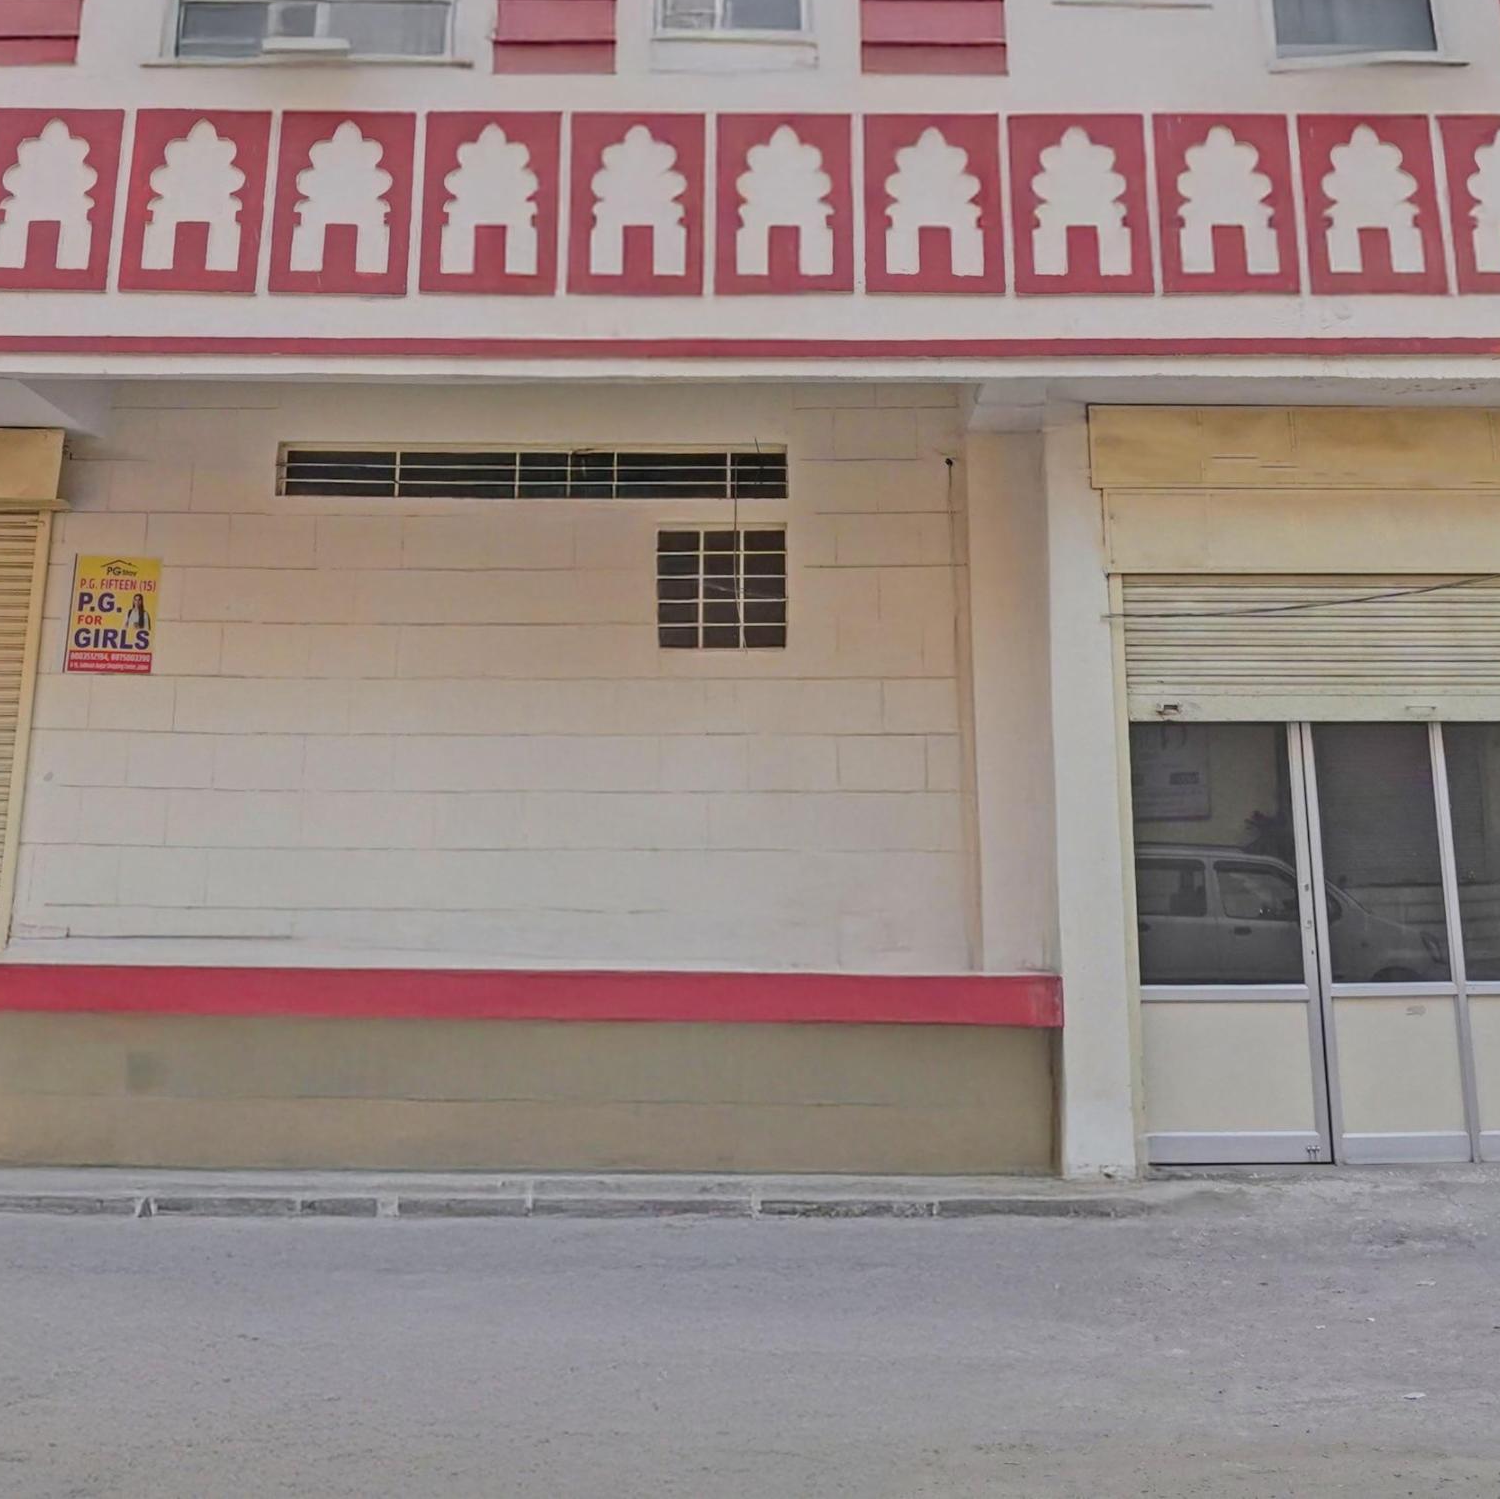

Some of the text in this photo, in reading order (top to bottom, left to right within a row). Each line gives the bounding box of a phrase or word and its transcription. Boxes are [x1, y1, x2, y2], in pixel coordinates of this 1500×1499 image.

[106, 566, 122, 576] PG
[80, 579, 156, 592] P.G. FIFTEEN (15)
[77, 592, 122, 613] P.G.
[77, 615, 102, 625] FOR
[74, 628, 150, 650] GIRLS
